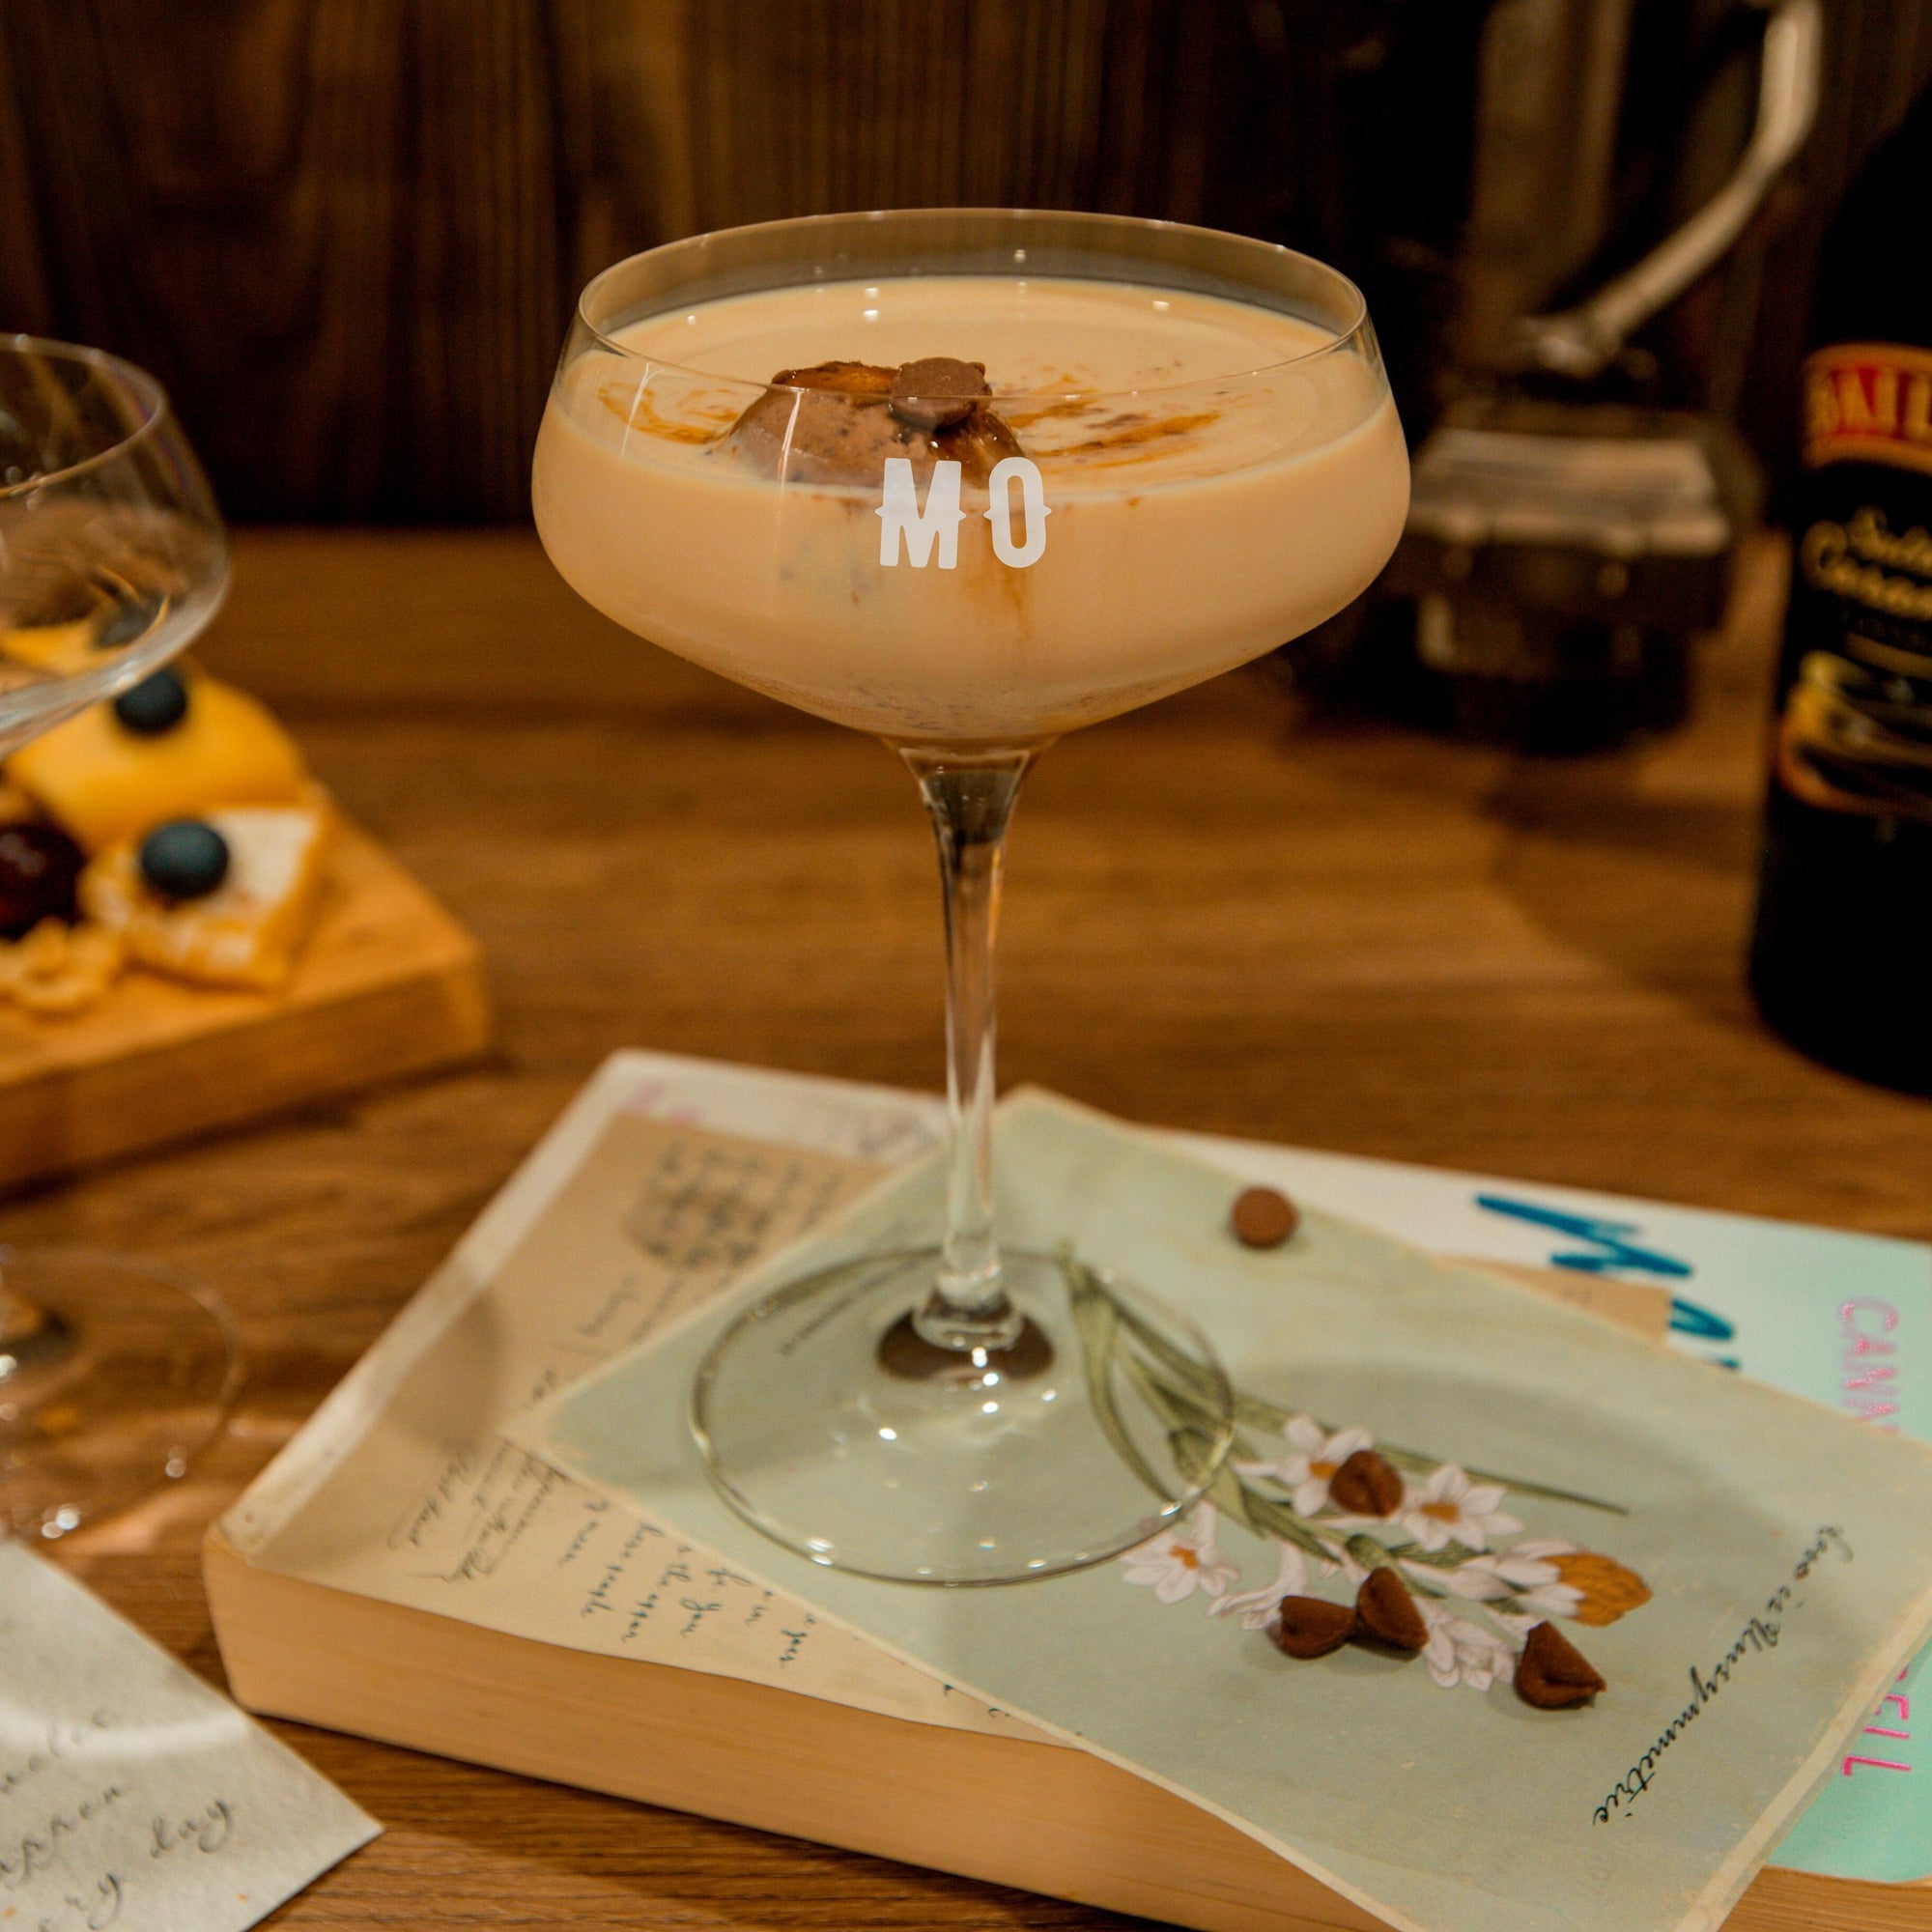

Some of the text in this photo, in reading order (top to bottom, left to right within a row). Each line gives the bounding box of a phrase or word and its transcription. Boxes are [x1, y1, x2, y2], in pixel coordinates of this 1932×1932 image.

[875, 457, 1052, 569] M O
[1766, 1585, 1804, 1615] is
[1593, 1616, 1780, 1826] Unsymmetric
